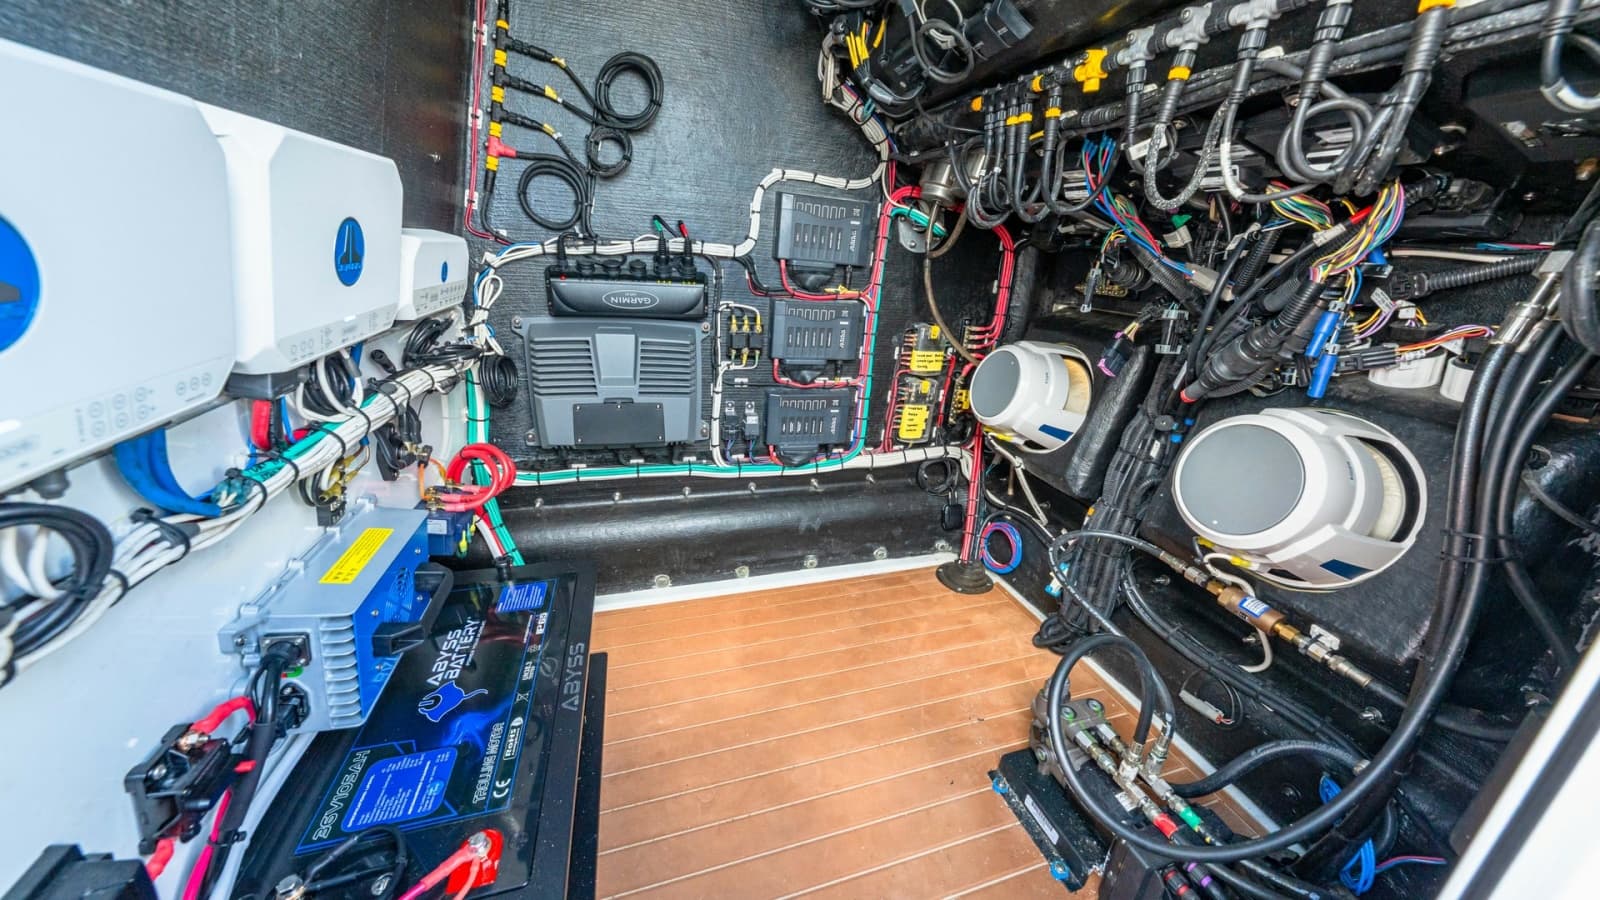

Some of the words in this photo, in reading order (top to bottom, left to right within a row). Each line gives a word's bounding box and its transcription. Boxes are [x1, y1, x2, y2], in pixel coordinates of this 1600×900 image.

[610, 296, 651, 304] GARMIN
[426, 628, 462, 686] ABYSS
[444, 619, 480, 679] BATTERY
[561, 642, 585, 711] ABYSS
[485, 721, 505, 755] MOTOR
[505, 728, 517, 757] RoHS
[312, 750, 371, 840] 36V105AH
